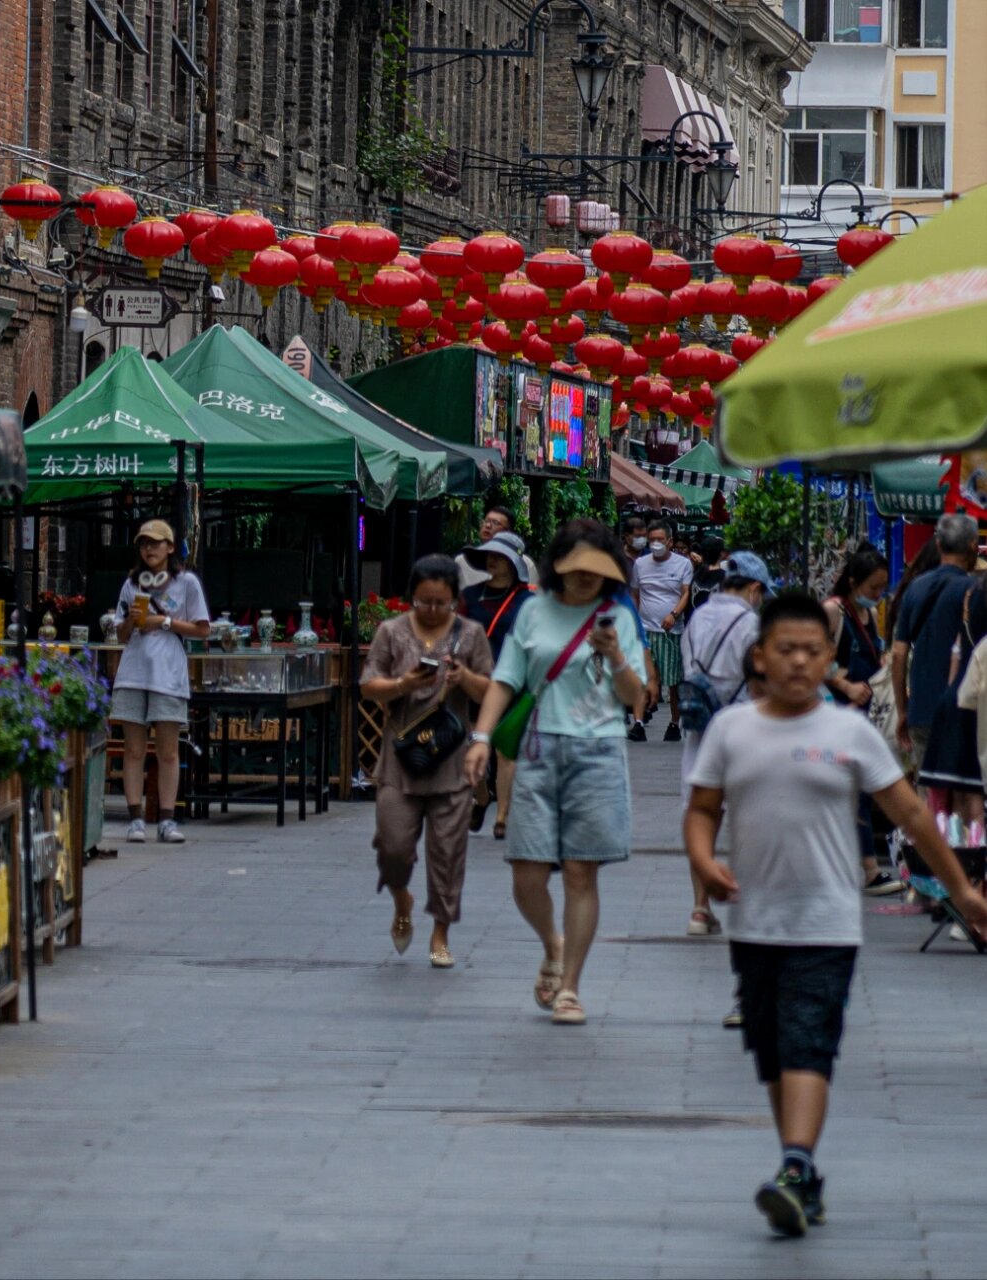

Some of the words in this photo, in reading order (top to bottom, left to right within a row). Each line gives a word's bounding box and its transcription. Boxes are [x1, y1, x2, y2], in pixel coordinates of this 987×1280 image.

[126, 296, 161, 305] 公共卫生间
[198, 390, 286, 422] 巴洛克
[41, 452, 144, 477] 东方树叶
